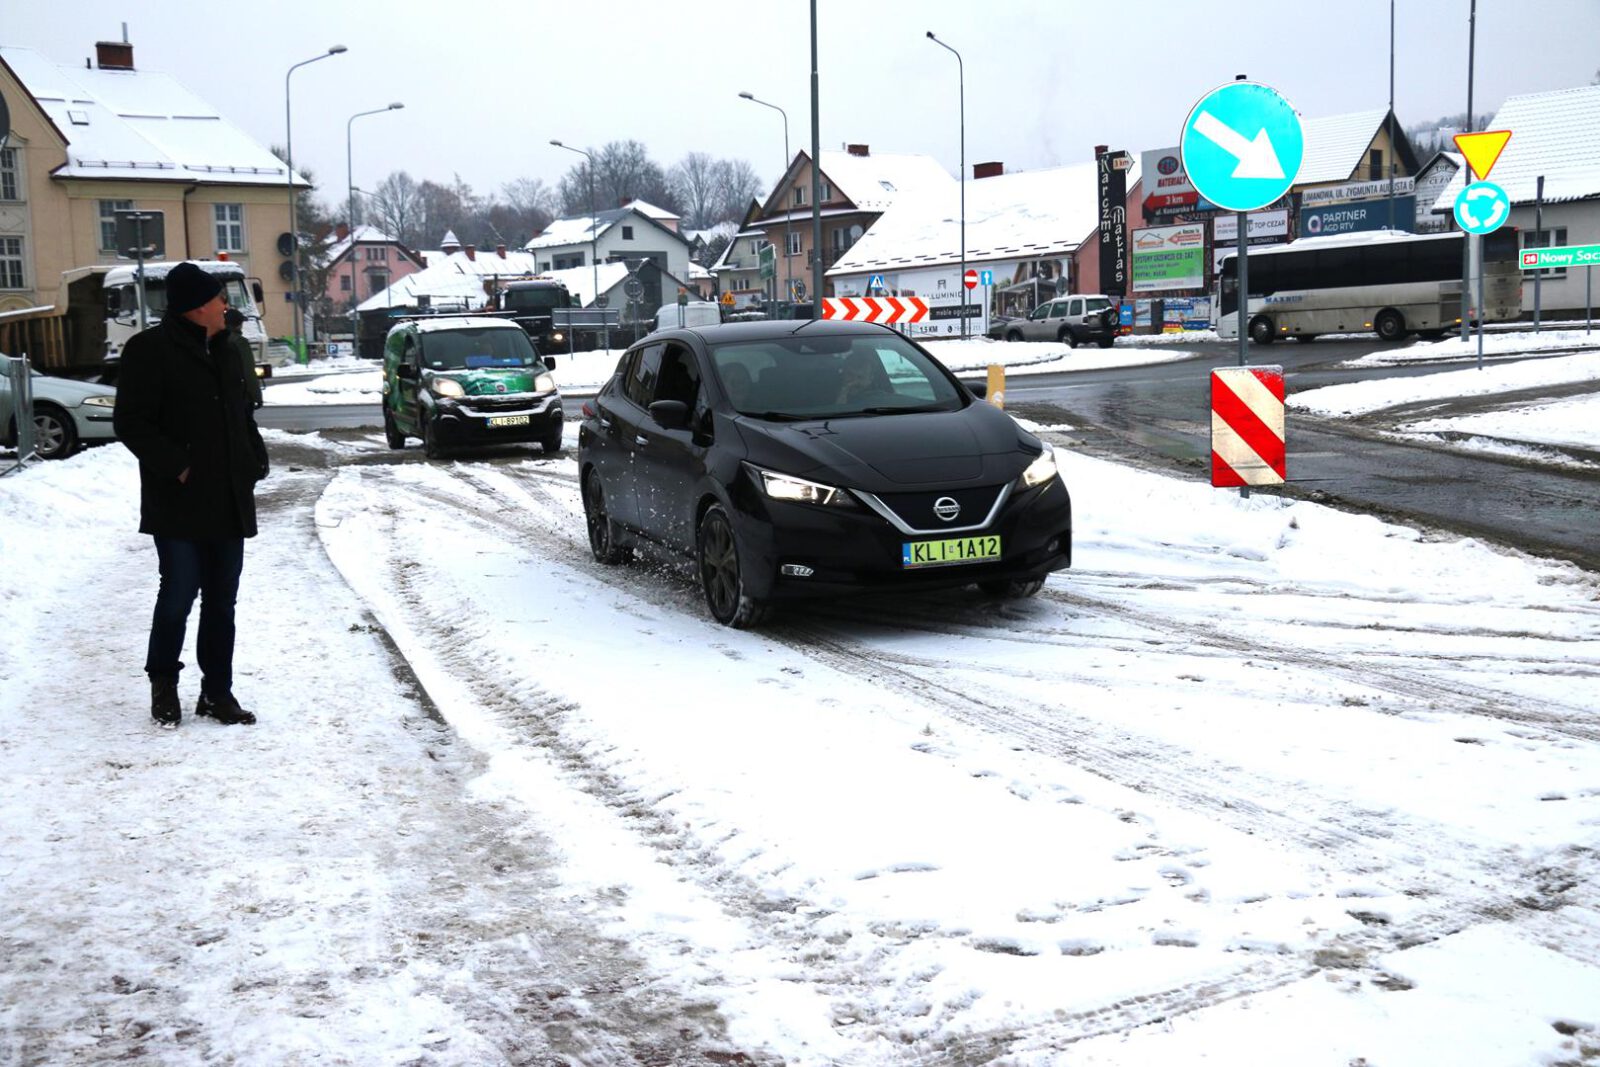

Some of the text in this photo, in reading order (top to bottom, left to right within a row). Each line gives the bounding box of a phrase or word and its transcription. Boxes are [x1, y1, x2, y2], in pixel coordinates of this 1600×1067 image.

[1346, 186, 1378, 197] ZYGMUNTA
[1409, 180, 1413, 190] 6
[1101, 155, 1111, 243] Karczma
[1171, 195, 1183, 204] km
[1323, 209, 1367, 223] PARTNER
[1266, 220, 1286, 229] CEZAR
[1323, 222, 1355, 232] AGD RTV
[1541, 253, 1573, 265] Nowy
[914, 542, 946, 563] KLI
[957, 538, 998, 559] 1A12
